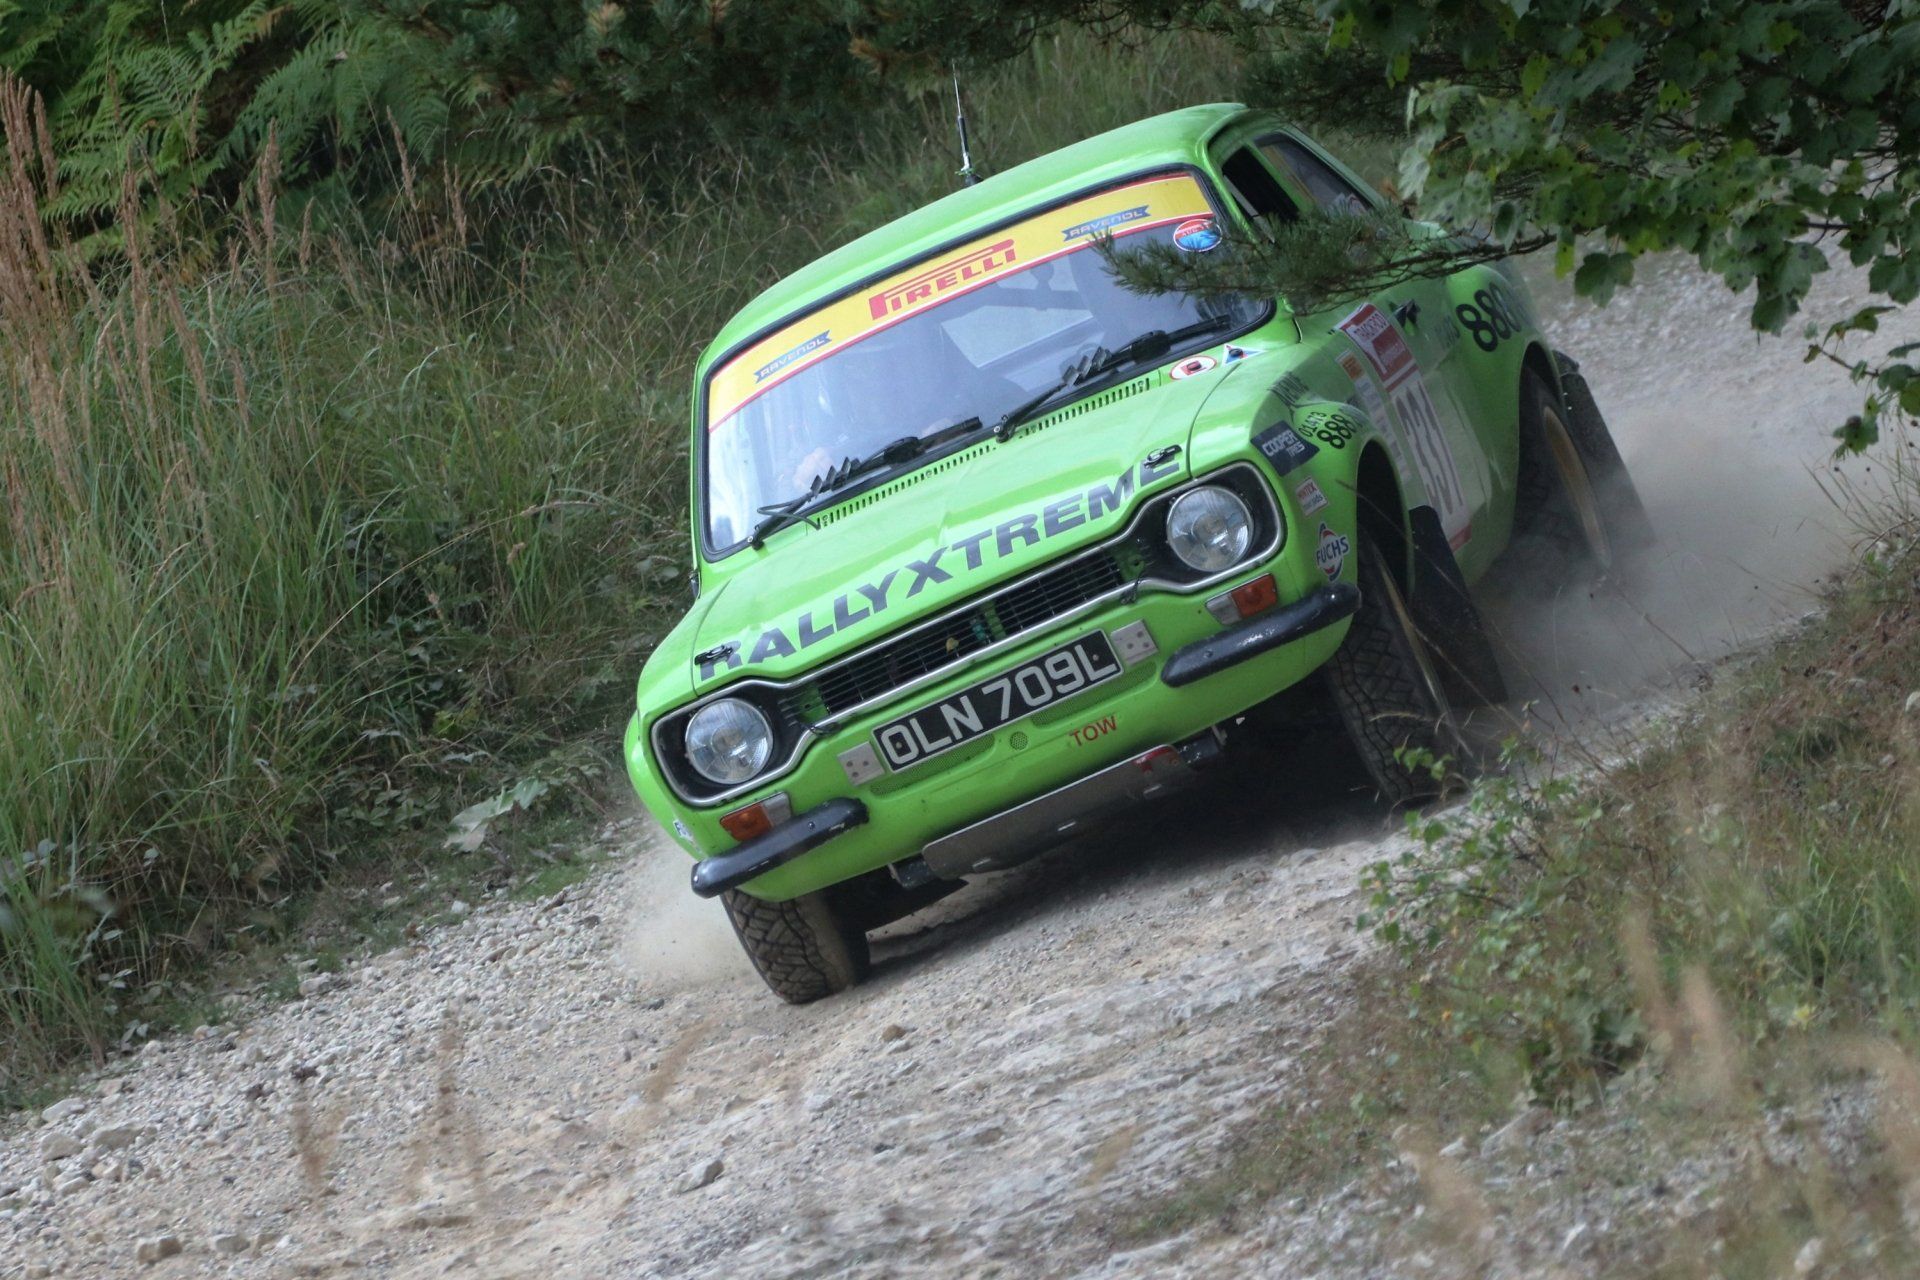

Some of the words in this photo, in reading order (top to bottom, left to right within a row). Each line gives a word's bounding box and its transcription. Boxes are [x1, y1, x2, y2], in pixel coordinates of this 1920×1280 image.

[1068, 208, 1143, 237] RAVENOL
[868, 238, 1016, 321] PIRELLI
[757, 335, 826, 379] RAVENOL
[1261, 429, 1298, 457] COOPER
[698, 455, 1180, 682] RALLYXTREME
[1316, 536, 1350, 566] FUCHS
[880, 704, 984, 768] OLN
[998, 643, 1120, 721] 709L
[1069, 714, 1118, 748] TOW
